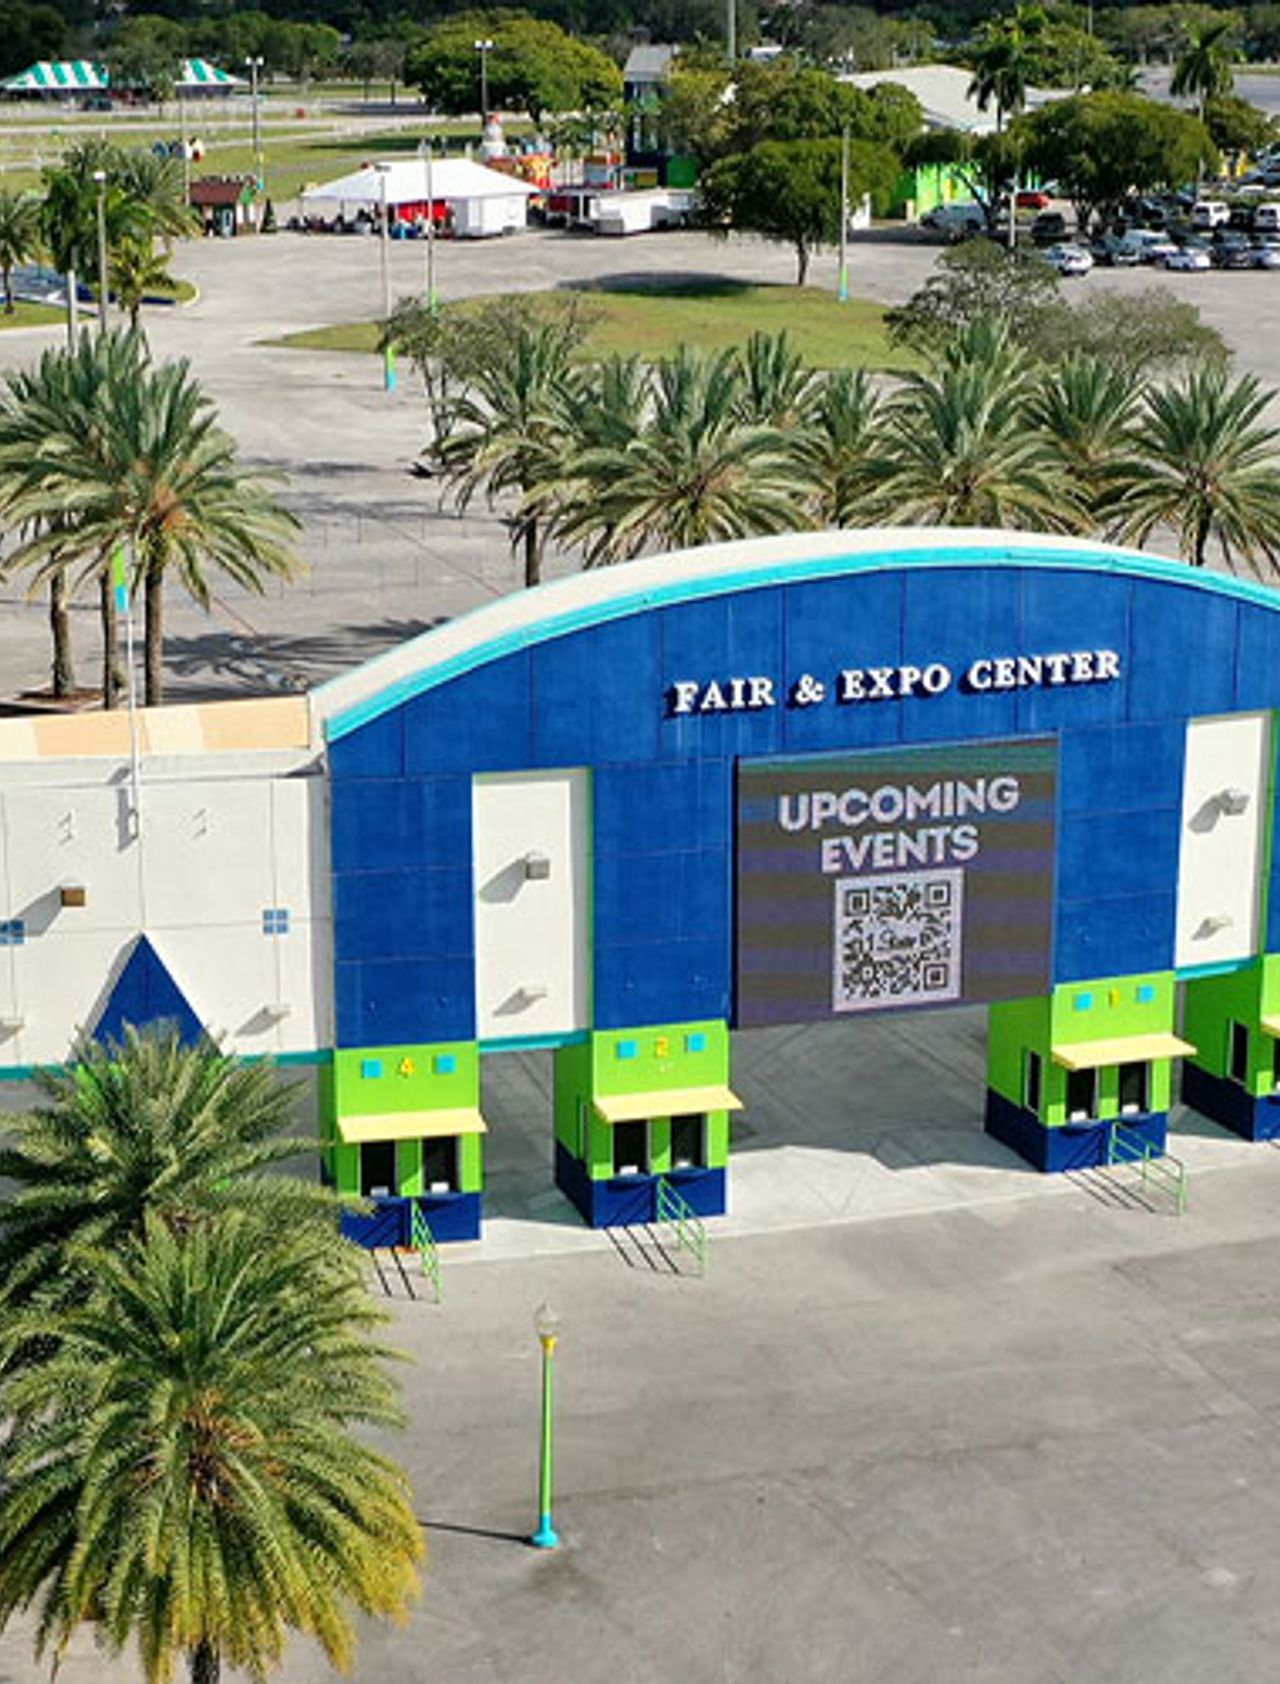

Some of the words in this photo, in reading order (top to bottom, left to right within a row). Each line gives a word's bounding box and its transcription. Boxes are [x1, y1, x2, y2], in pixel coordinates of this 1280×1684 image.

[673, 677, 776, 713] FAIR
[795, 673, 825, 704] &
[841, 663, 952, 700] EXPO
[968, 650, 1120, 690] CENTER
[778, 776, 1020, 832] UPCOMING
[821, 824, 979, 873] EVENTS
[399, 1056, 415, 1078] 4
[655, 1036, 670, 1057] 2
